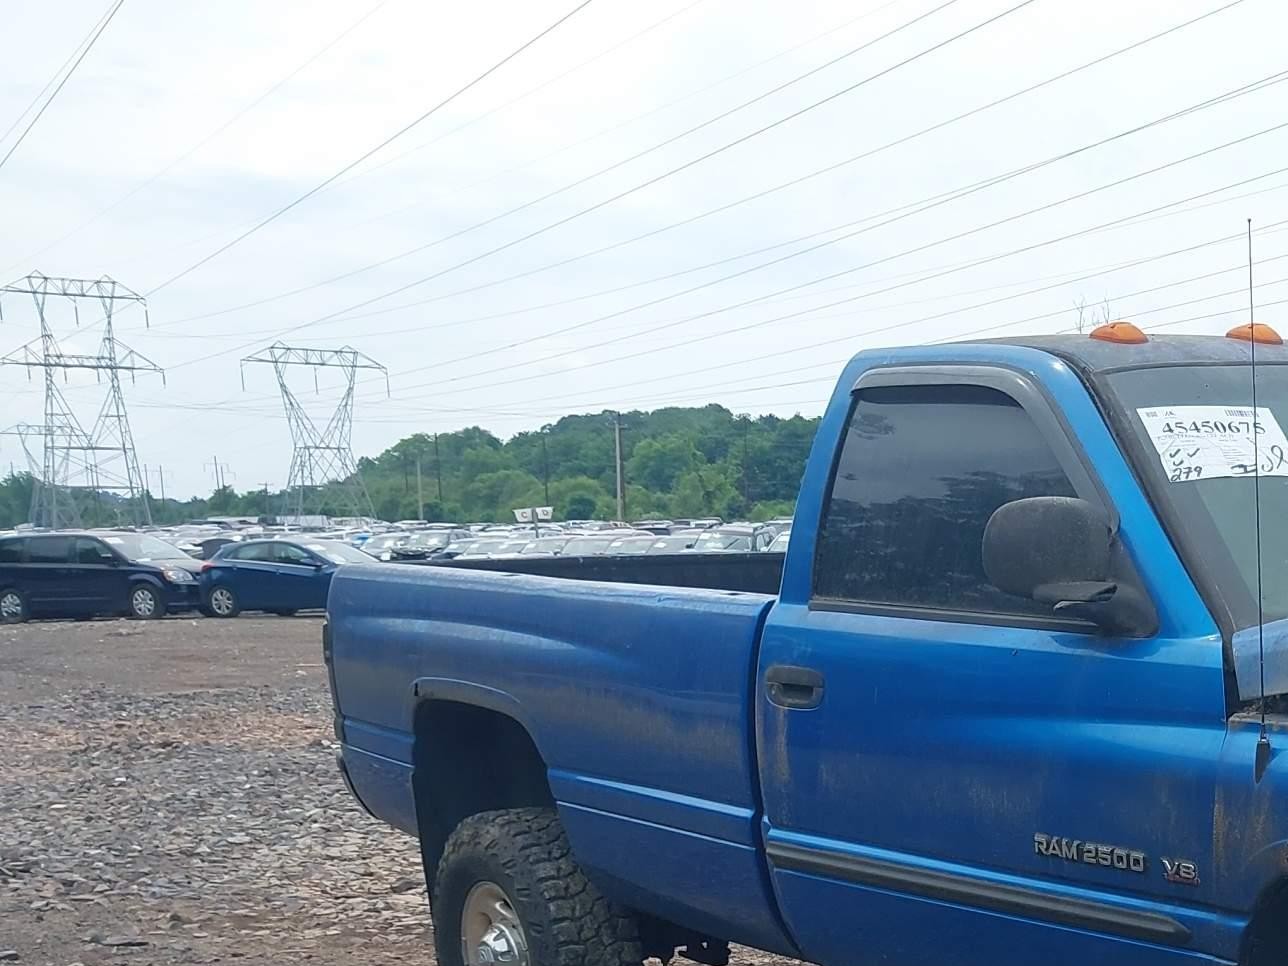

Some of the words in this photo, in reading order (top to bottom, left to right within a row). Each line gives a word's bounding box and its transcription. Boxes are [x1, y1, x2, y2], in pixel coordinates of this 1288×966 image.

[1162, 421, 1266, 435] 45450675
[1034, 833, 1080, 860] RAM
[1083, 844, 1145, 873] 2500
[1160, 856, 1197, 880] V8
